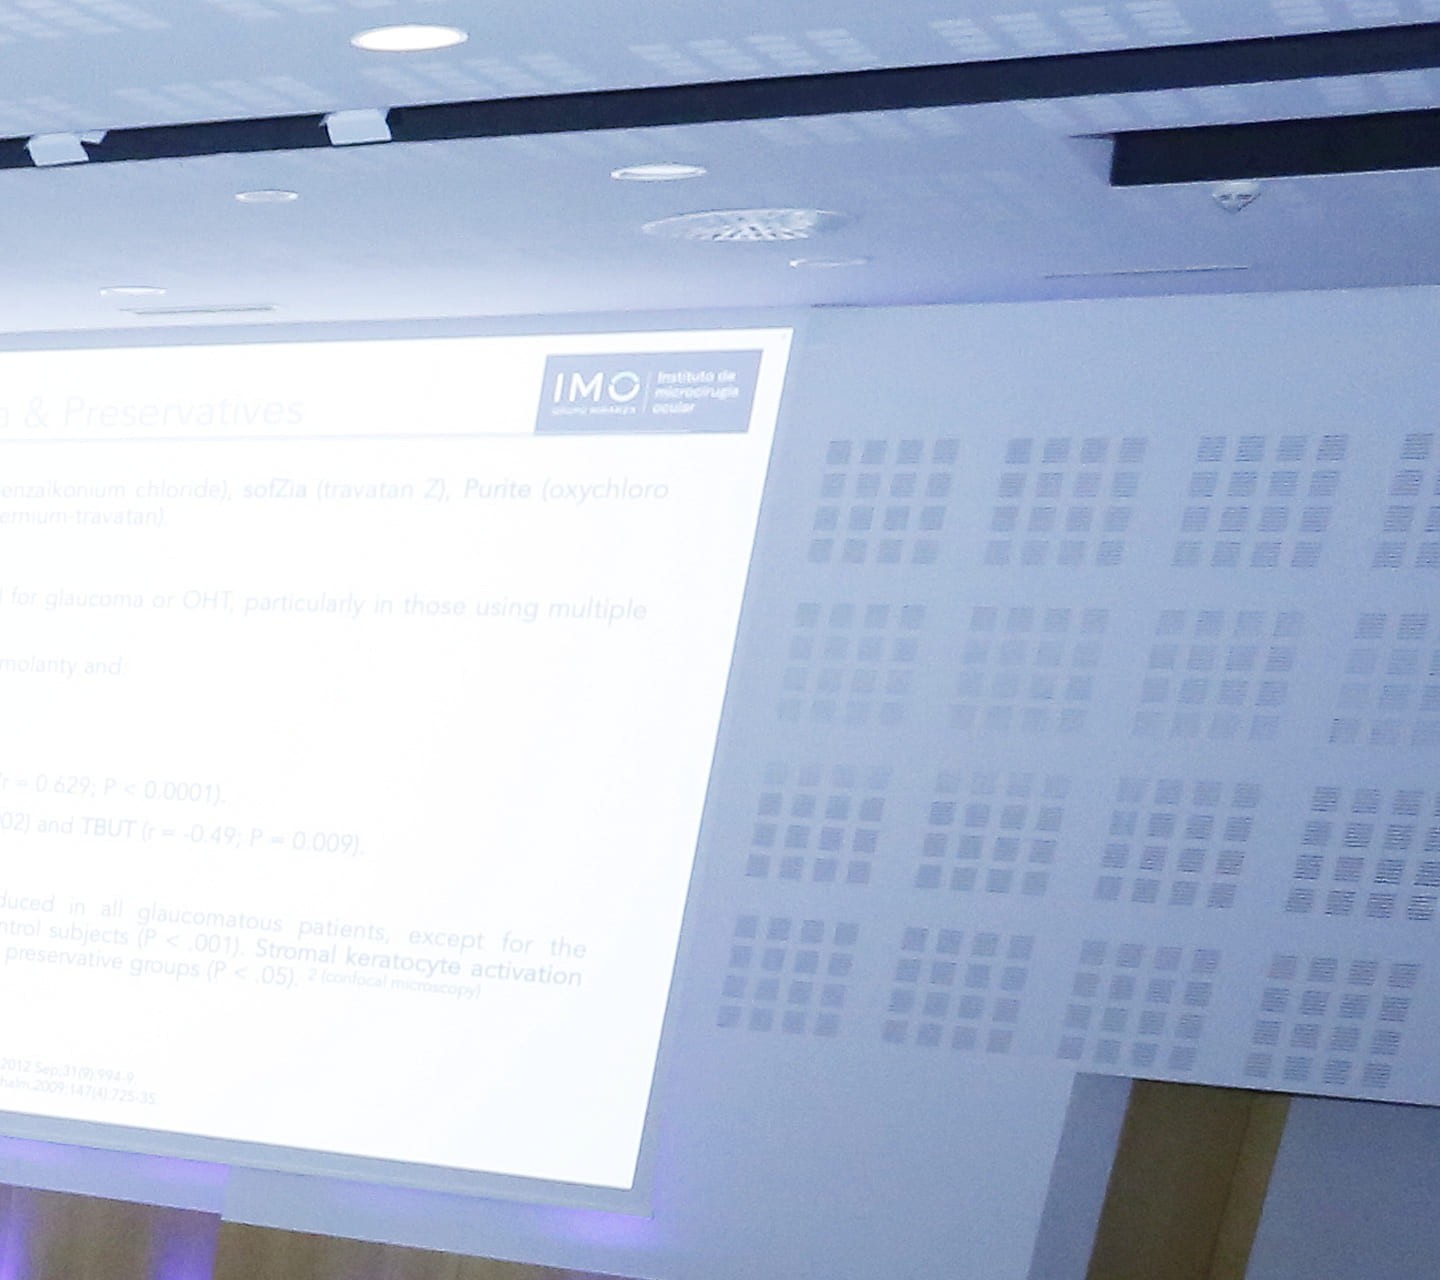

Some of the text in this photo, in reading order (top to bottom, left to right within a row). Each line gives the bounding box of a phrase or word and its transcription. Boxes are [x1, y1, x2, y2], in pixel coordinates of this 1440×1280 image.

[554, 371, 640, 403] IMO
[24, 395, 49, 430] &
[63, 395, 305, 429] Preservatives
